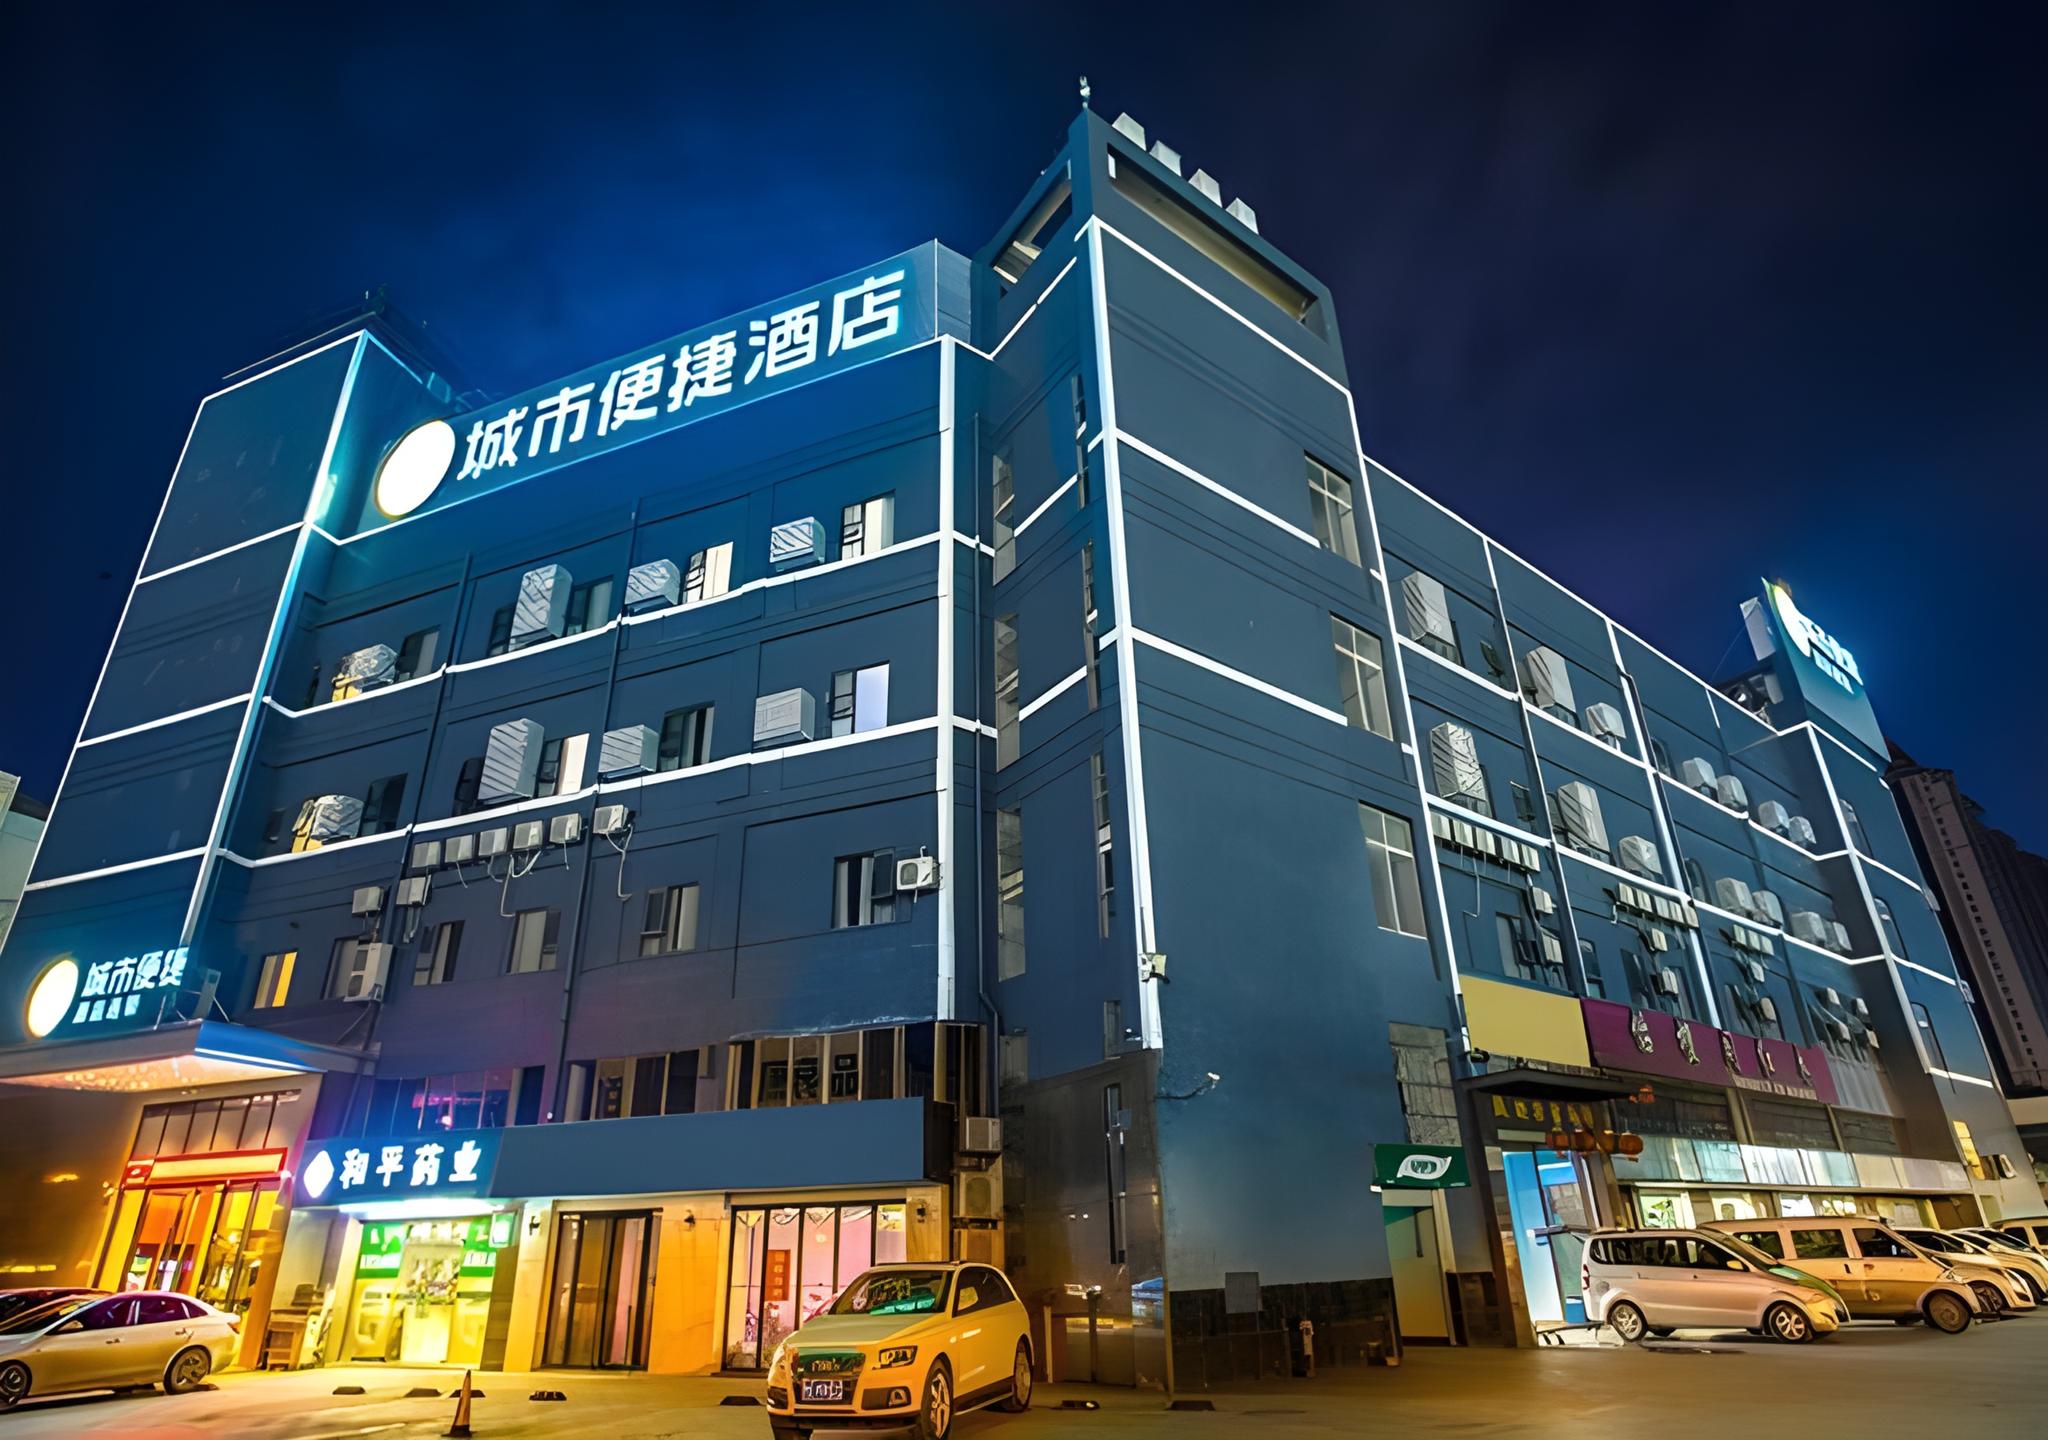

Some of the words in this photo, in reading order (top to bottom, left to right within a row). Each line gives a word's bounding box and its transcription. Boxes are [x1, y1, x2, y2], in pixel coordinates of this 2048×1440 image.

[456, 268, 907, 481] 城市便捷酒店
[338, 1140, 483, 1190] 和平药业
